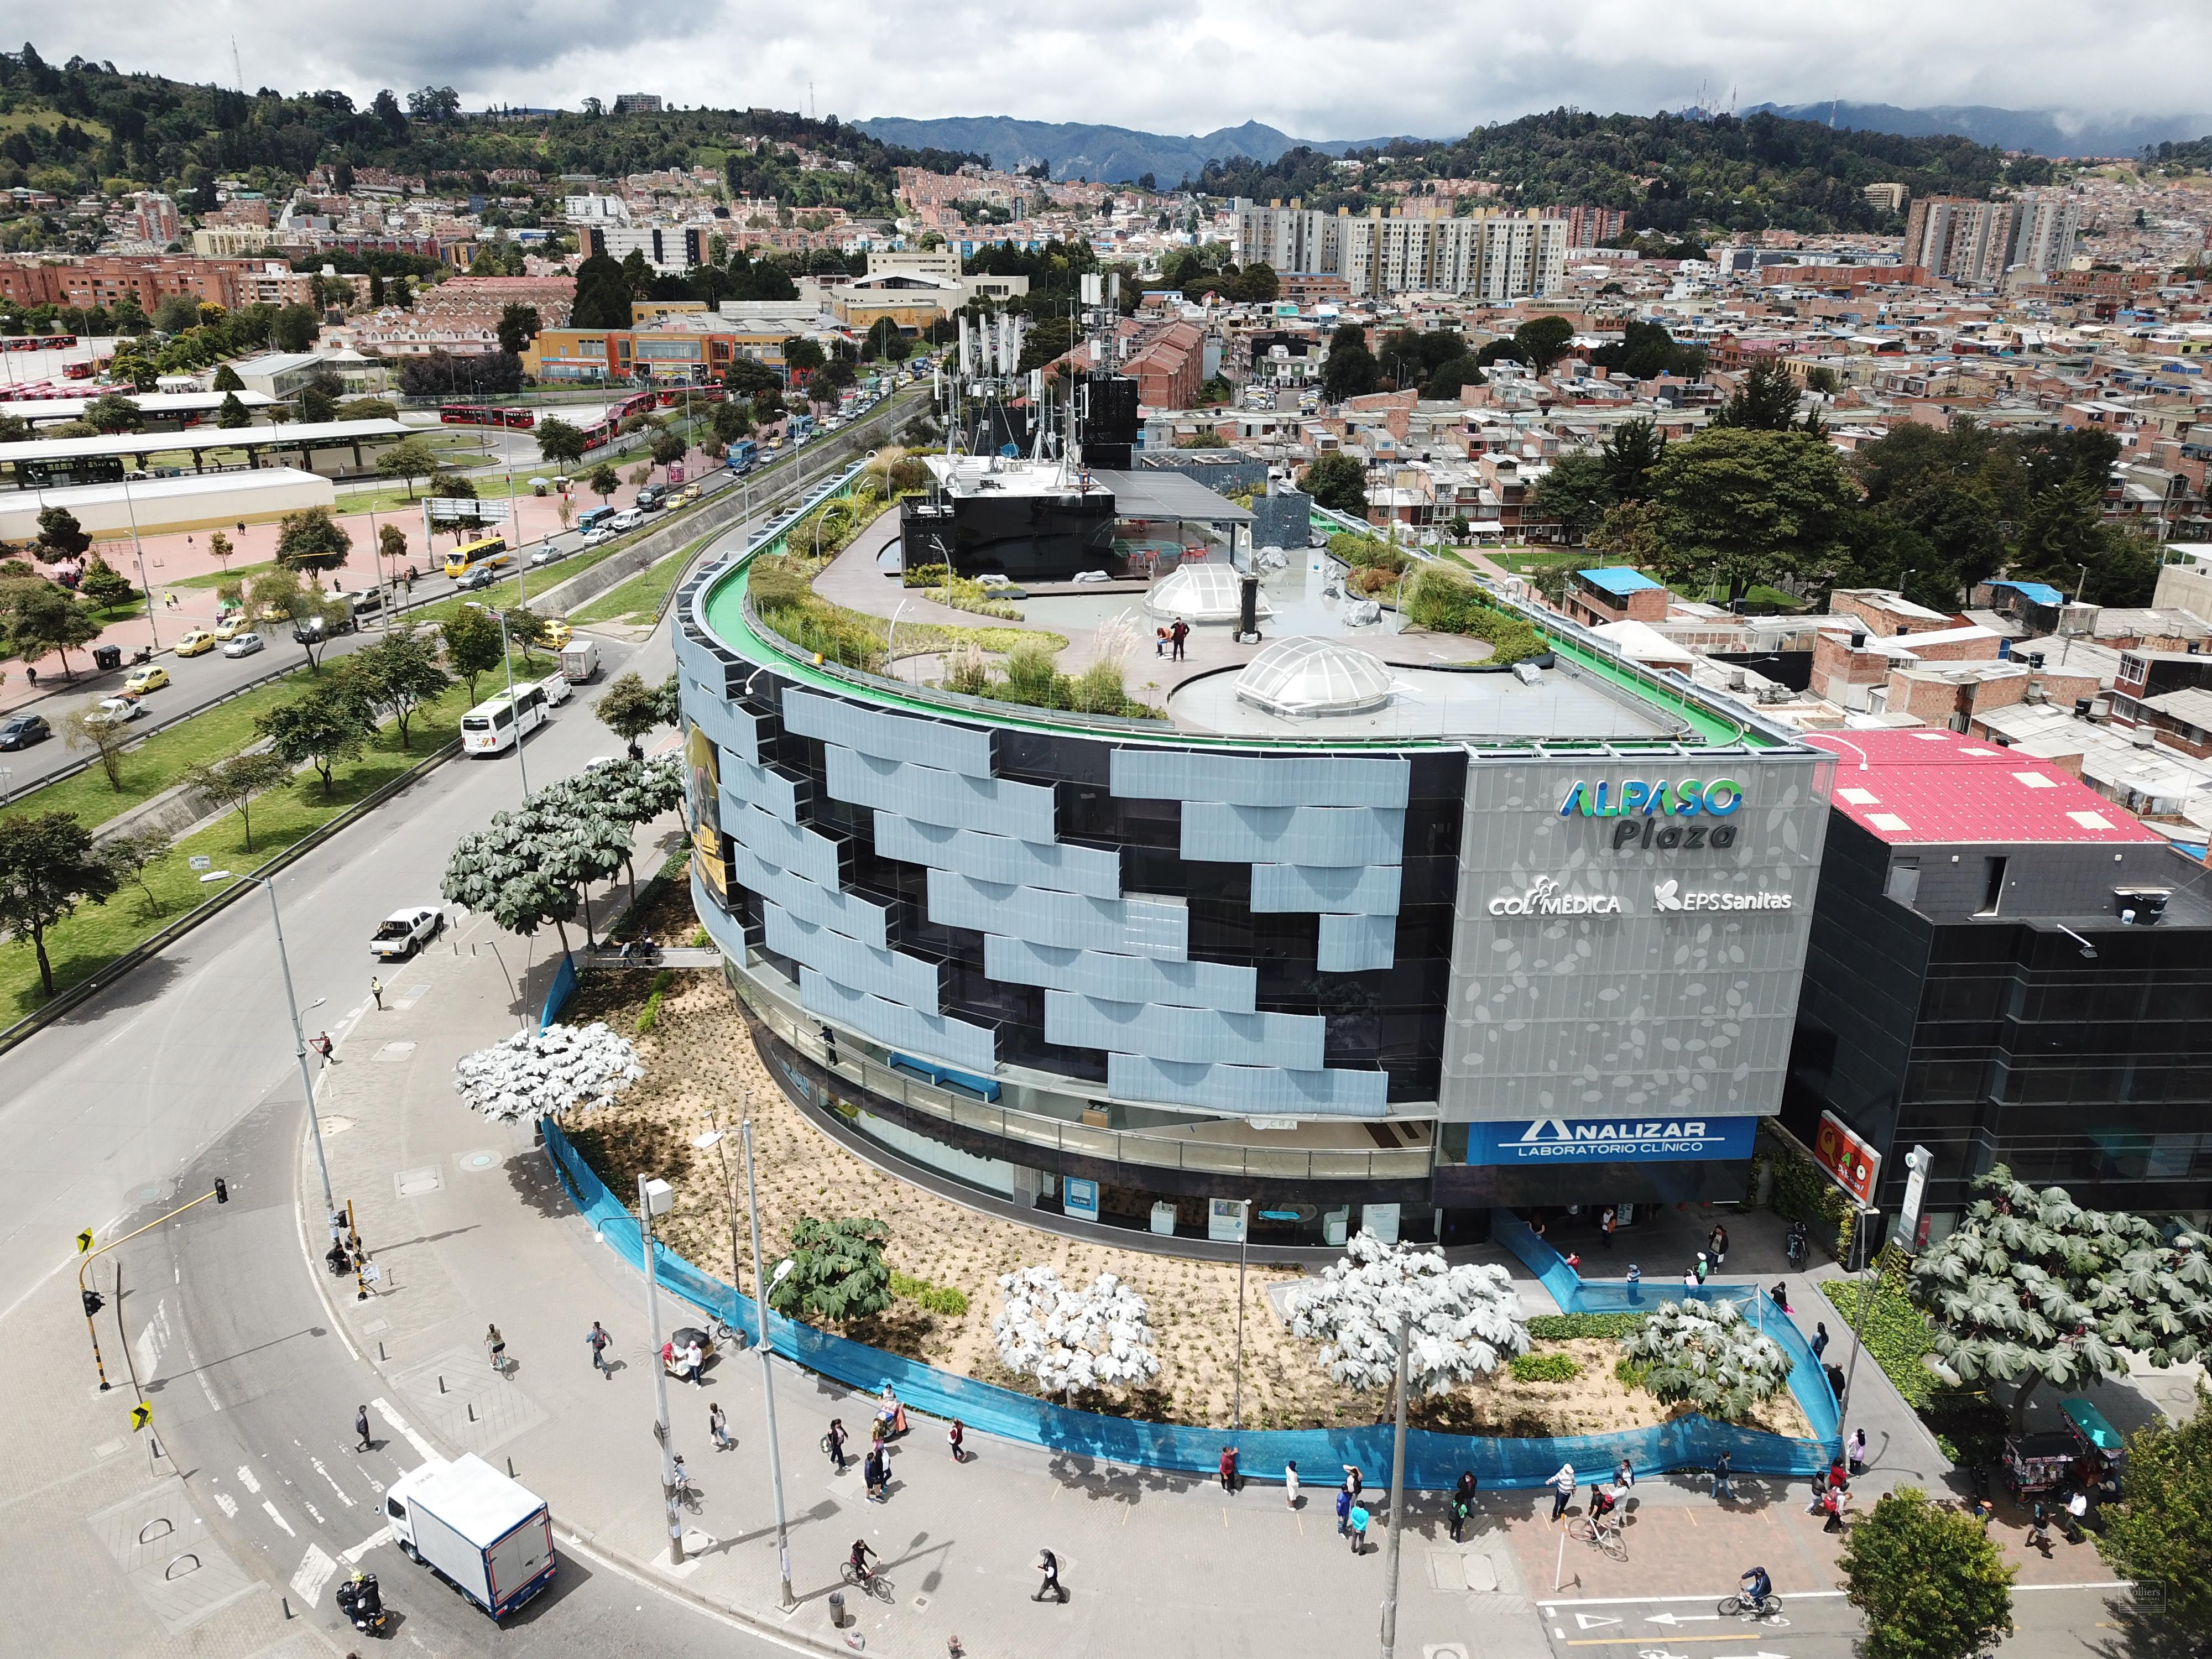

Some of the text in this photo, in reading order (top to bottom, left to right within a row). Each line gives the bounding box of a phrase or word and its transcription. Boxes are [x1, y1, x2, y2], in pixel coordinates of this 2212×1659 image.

[1559, 778, 1742, 817] ALPASO
[1613, 818, 1738, 850] Plaza
[1520, 1119, 1706, 1141] ANALIZAR
[1519, 1141, 1703, 1156] LABORATORIO CLÍNICO
